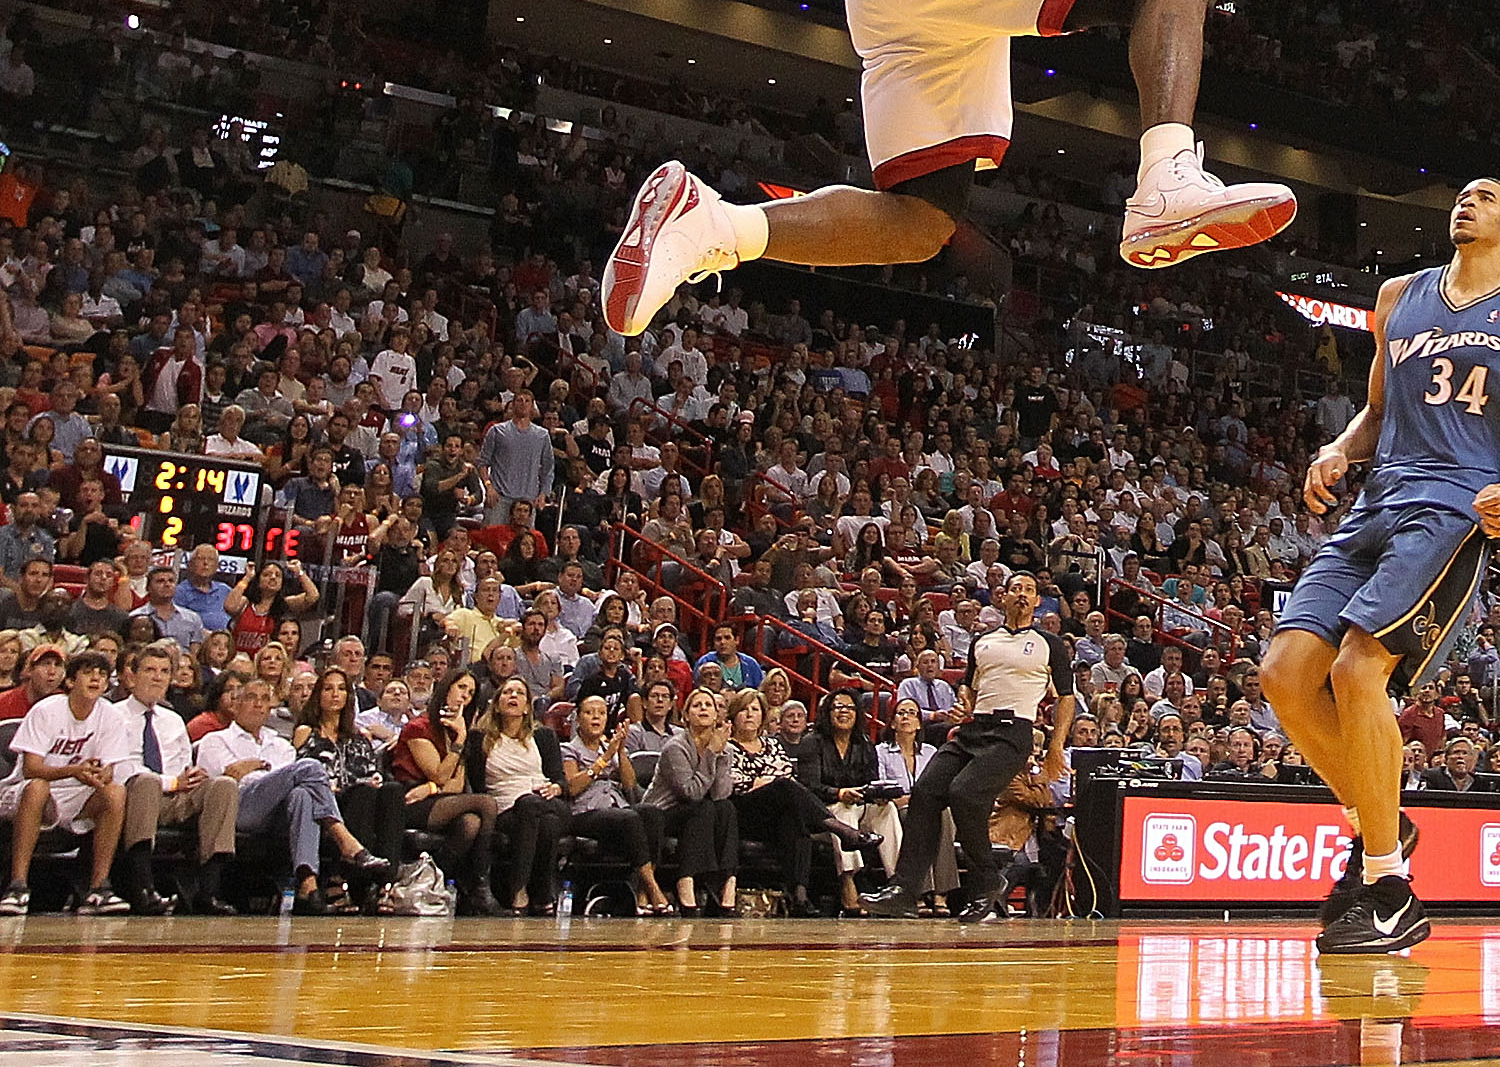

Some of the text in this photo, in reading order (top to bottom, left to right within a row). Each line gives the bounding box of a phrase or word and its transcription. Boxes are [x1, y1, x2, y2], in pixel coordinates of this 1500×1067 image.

[1424, 356, 1489, 415] 34
[155, 461, 225, 494] 2:14
[217, 503, 253, 518] WIZARDS
[162, 516, 183, 546] 2
[215, 522, 254, 552] 37
[336, 535, 369, 546] MIAMI
